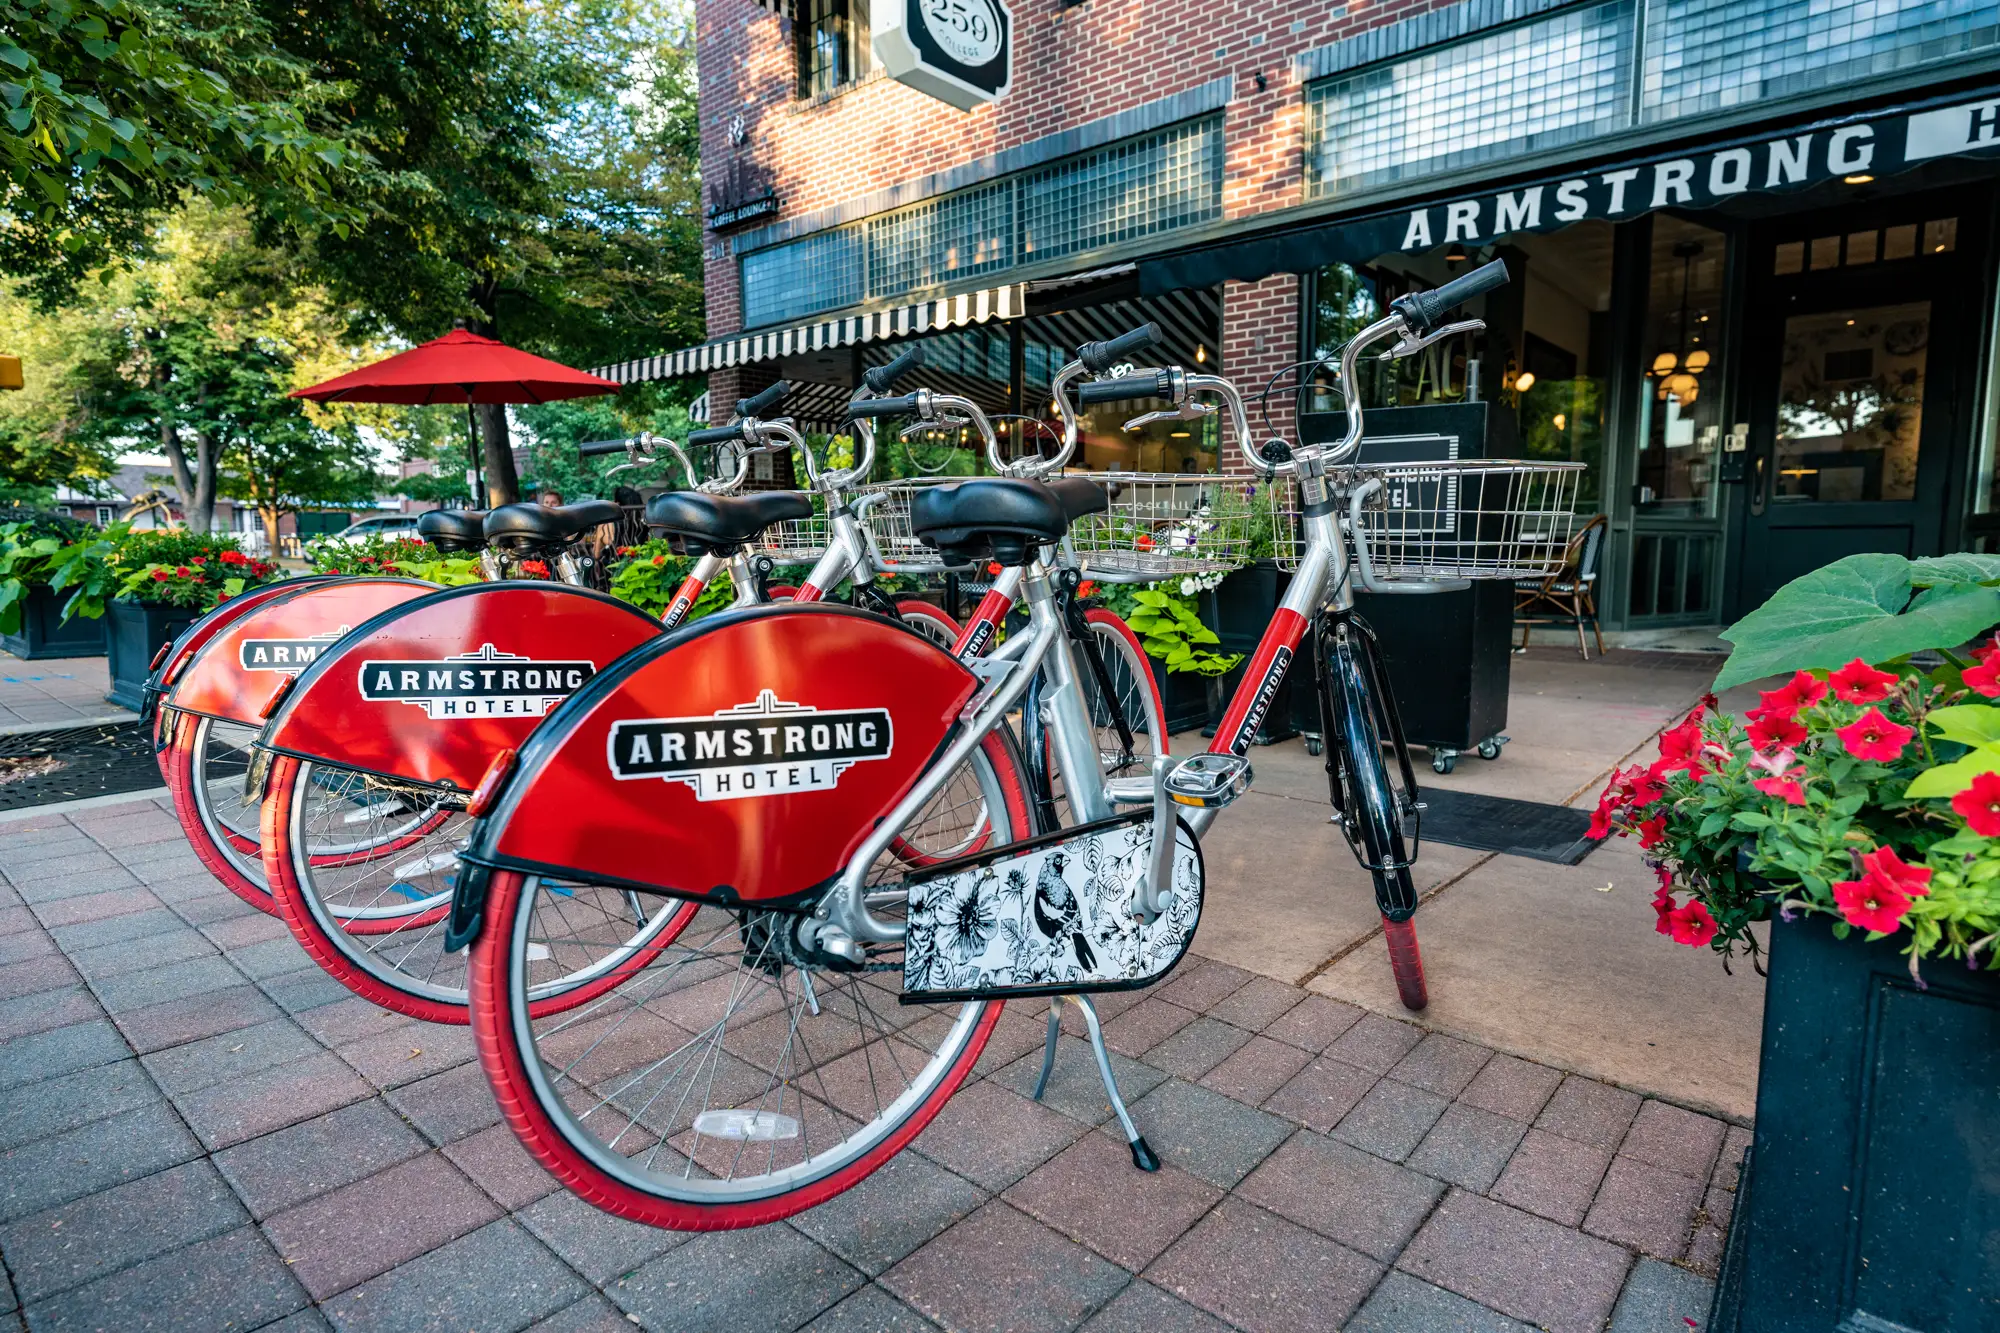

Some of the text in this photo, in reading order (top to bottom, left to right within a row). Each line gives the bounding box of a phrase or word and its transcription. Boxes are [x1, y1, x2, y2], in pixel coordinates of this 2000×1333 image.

[931, 0, 988, 43] 259
[1400, 123, 1876, 251] ARMSTRONG
[713, 200, 767, 228] COFFEE LOUNGE
[252, 645, 326, 664] ARM
[961, 628, 989, 661] RONG
[374, 669, 583, 692] ARMSTRONG
[444, 700, 533, 715] HOTEL
[1239, 656, 1288, 750] ARMSTRONG
[628, 721, 877, 765] ARMSTRONG
[716, 767, 822, 792] HOTEL
